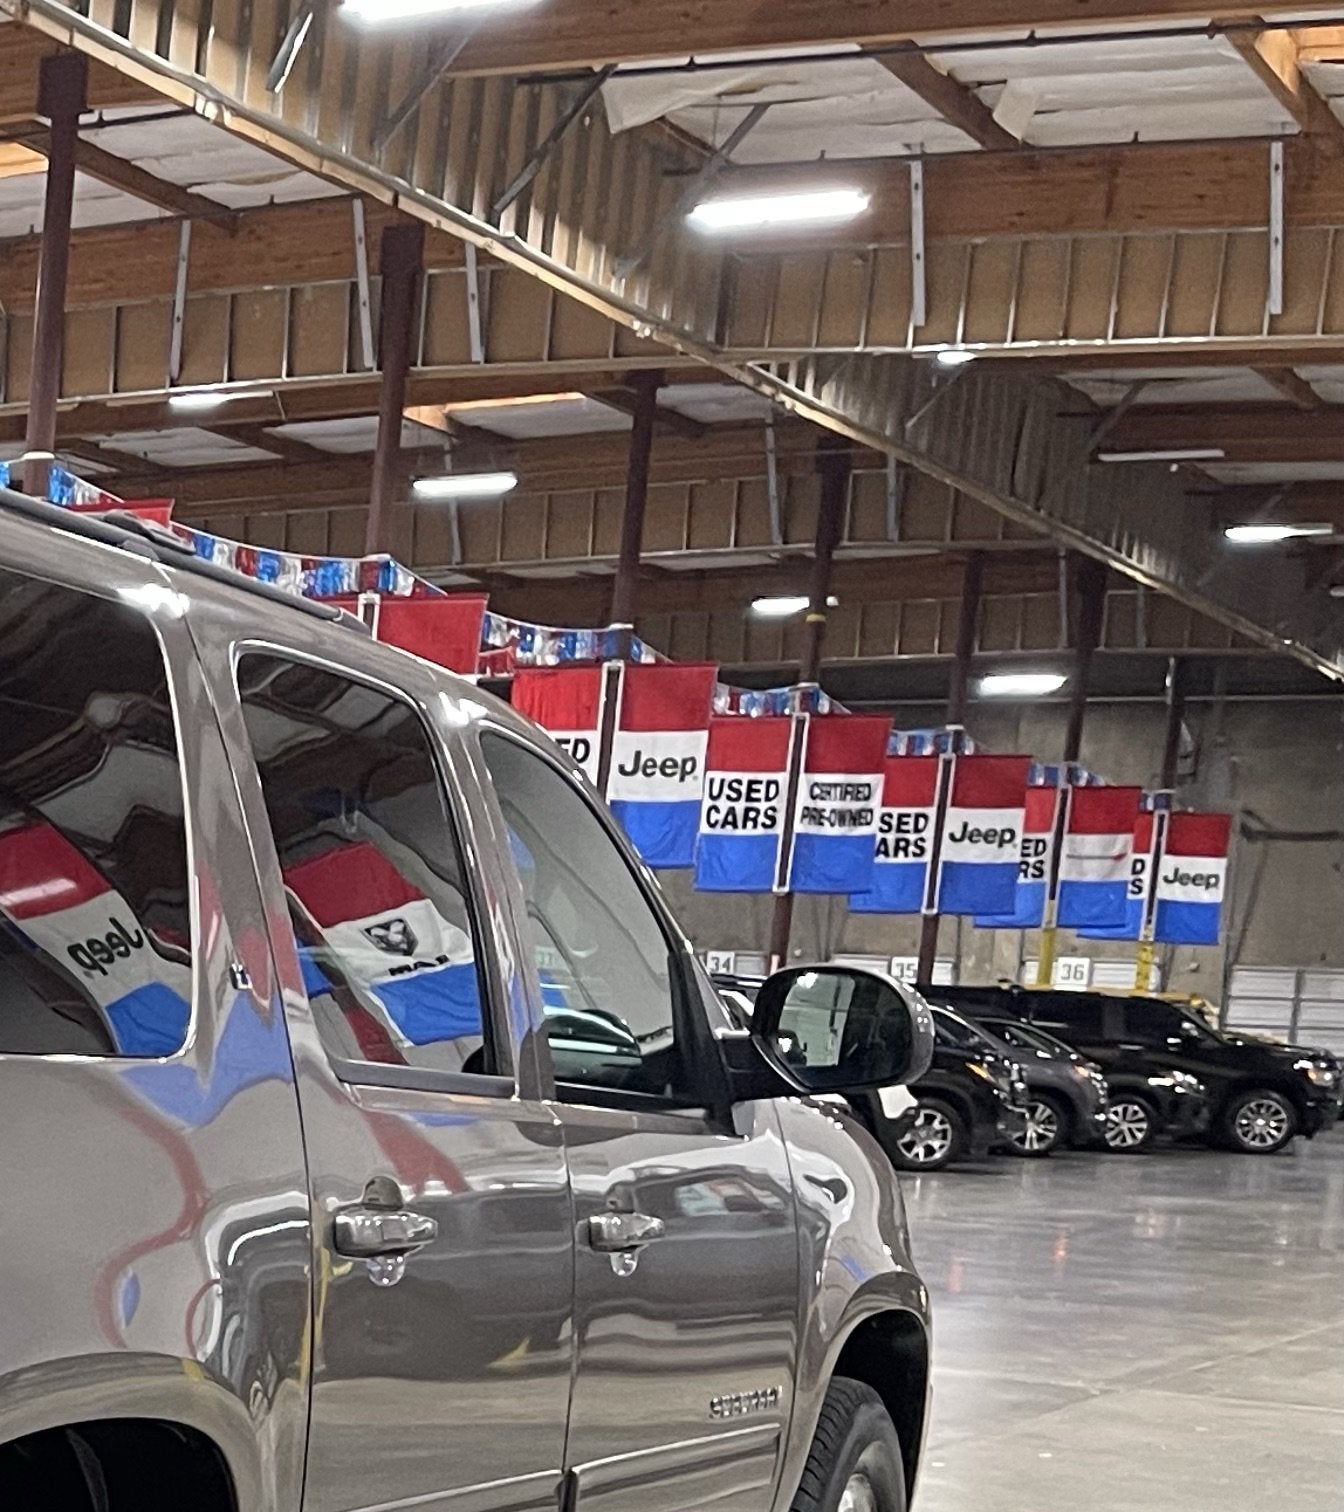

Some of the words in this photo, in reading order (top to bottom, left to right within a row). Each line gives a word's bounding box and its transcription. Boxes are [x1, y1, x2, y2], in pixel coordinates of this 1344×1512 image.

[618, 750, 698, 783] Jeep
[709, 777, 780, 803] USED
[706, 804, 777, 830] CARS
[878, 812, 929, 834] SED
[948, 820, 1017, 849] Jeep
[874, 837, 926, 858] ARS
[1162, 867, 1221, 891] Jeep
[710, 956, 731, 974] 34
[1060, 963, 1085, 981] 36
